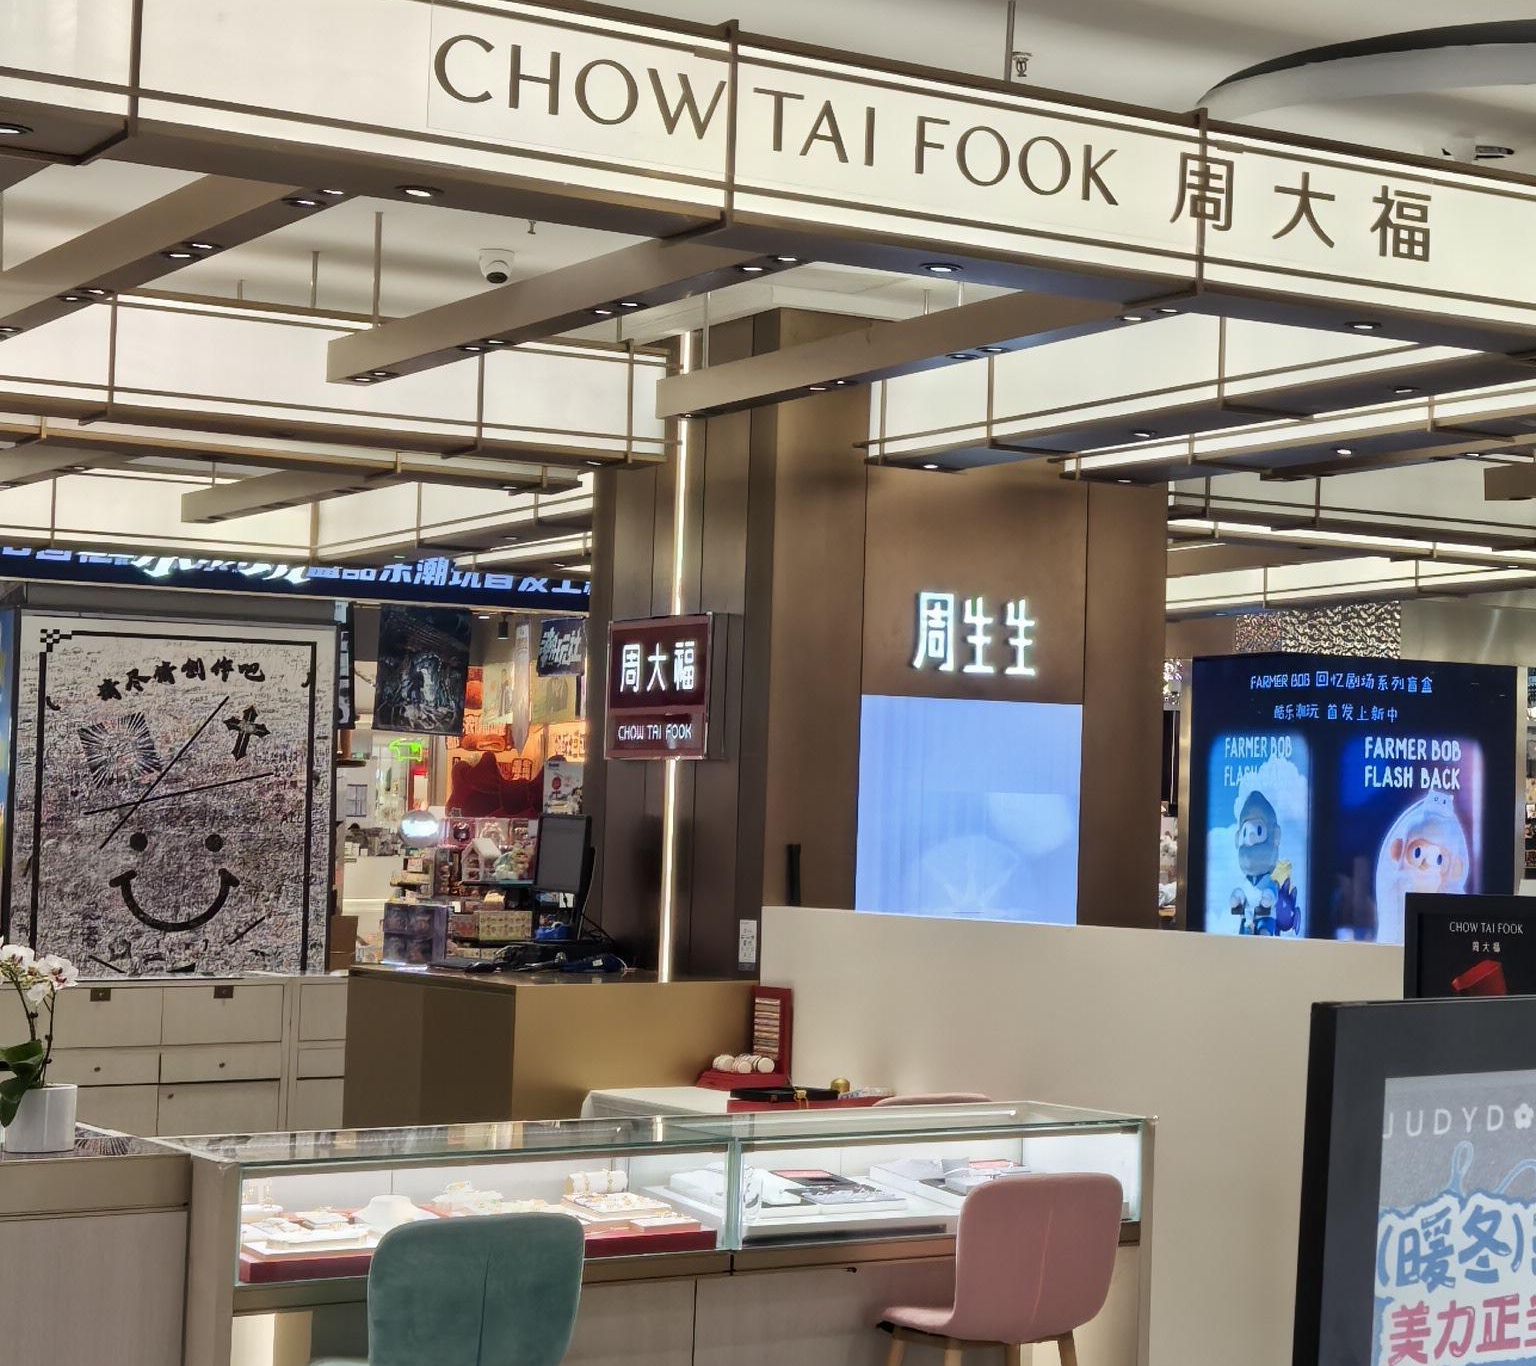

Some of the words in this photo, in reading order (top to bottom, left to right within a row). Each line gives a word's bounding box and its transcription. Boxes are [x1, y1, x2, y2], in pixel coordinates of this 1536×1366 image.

[434, 34, 728, 140] CHOW
[753, 87, 876, 166] TAI
[914, 115, 1119, 206] FOOK
[1169, 151, 1433, 262] 周大福
[912, 591, 1036, 676] 周生生
[620, 640, 696, 693] 周大福
[1250, 674, 1288, 690] FARMER
[1327, 703, 1399, 724] 首发上新中
[617, 725, 644, 740] CHOW
[647, 725, 662, 740] TAI
[666, 723, 692, 740] FOOK
[1225, 736, 1267, 759] FARMER
[1270, 735, 1293, 758] BOB
[1364, 736, 1428, 761] FARMER
[1431, 739, 1462, 762] BOB
[1364, 765, 1413, 789] FLASH
[1421, 766, 1461, 790] BACK
[1450, 921, 1478, 933] CHOW
[1481, 922, 1495, 933] TAI
[1497, 922, 1524, 934] FOOK
